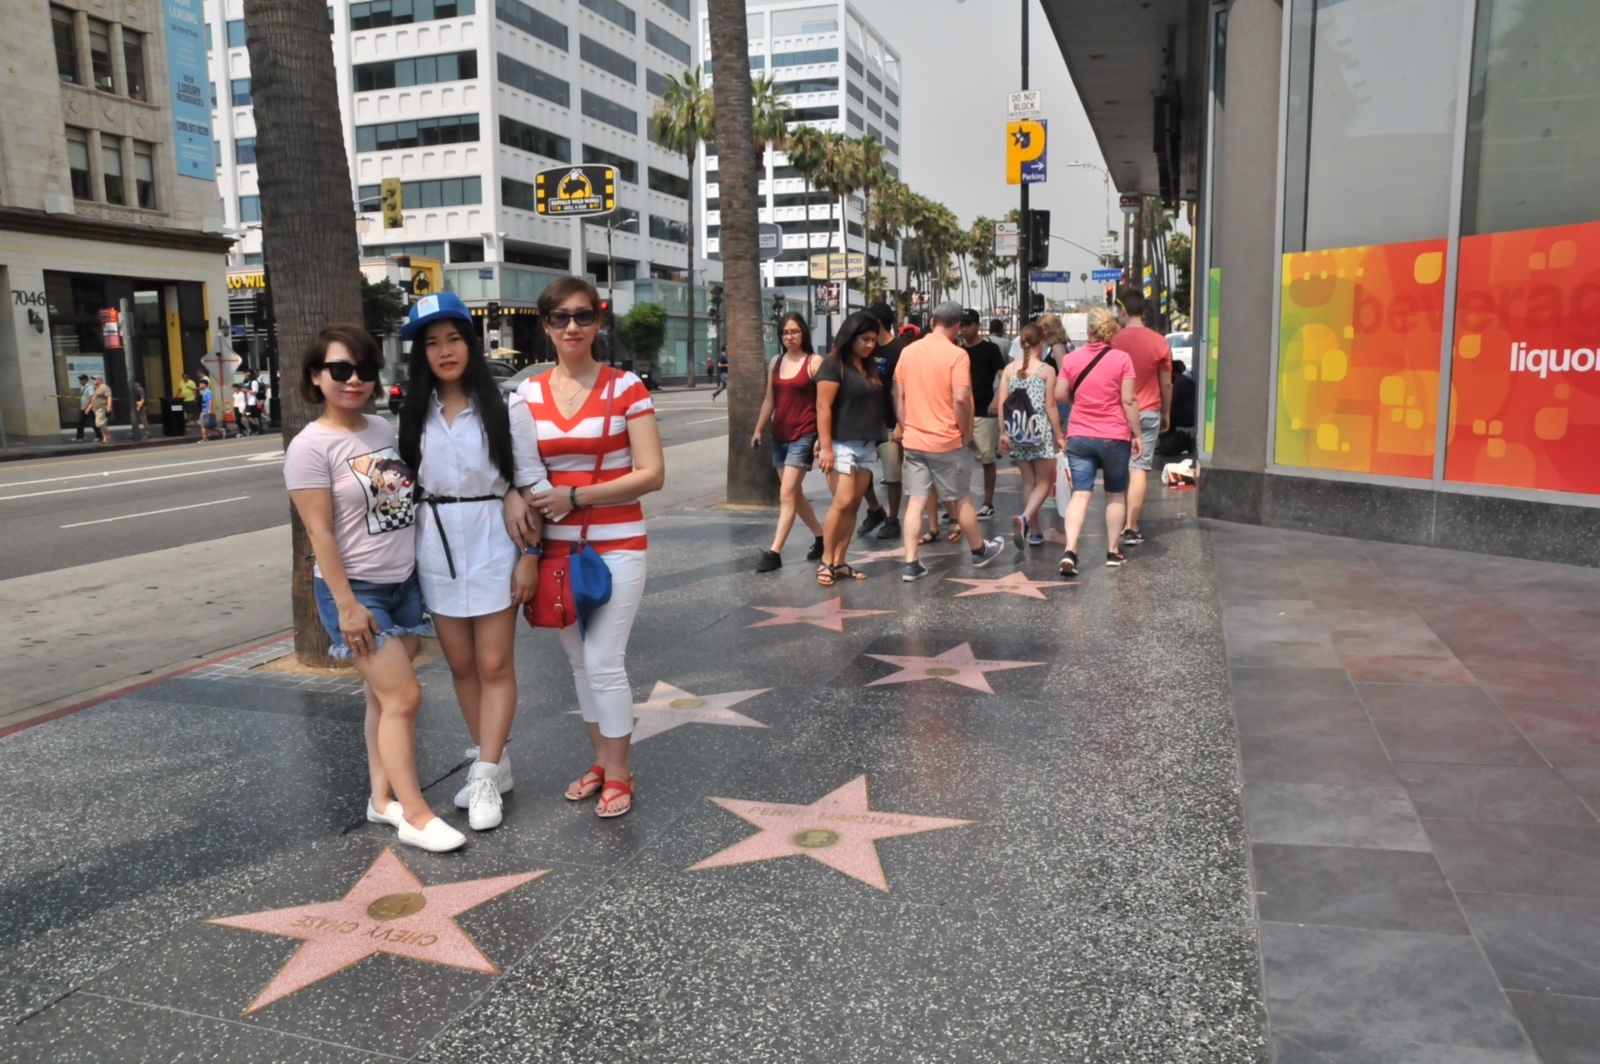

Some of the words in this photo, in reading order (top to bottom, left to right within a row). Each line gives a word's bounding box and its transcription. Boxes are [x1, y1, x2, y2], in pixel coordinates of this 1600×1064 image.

[168, 5, 198, 25] LEASING
[183, 74, 194, 84] NEW
[177, 81, 201, 98] LUXURY
[1012, 94, 1021, 103] DO
[1024, 92, 1037, 101] NOT
[1013, 102, 1035, 111] BLOCK
[1022, 172, 1046, 183] Parking
[1119, 195, 1141, 206] CVS
[1093, 271, 1122, 280] Sycamore
[12, 290, 46, 306] 7046
[818, 811, 918, 828] MARSHALL
[291, 915, 361, 935] CHASE
[363, 925, 439, 947] CHEVY
